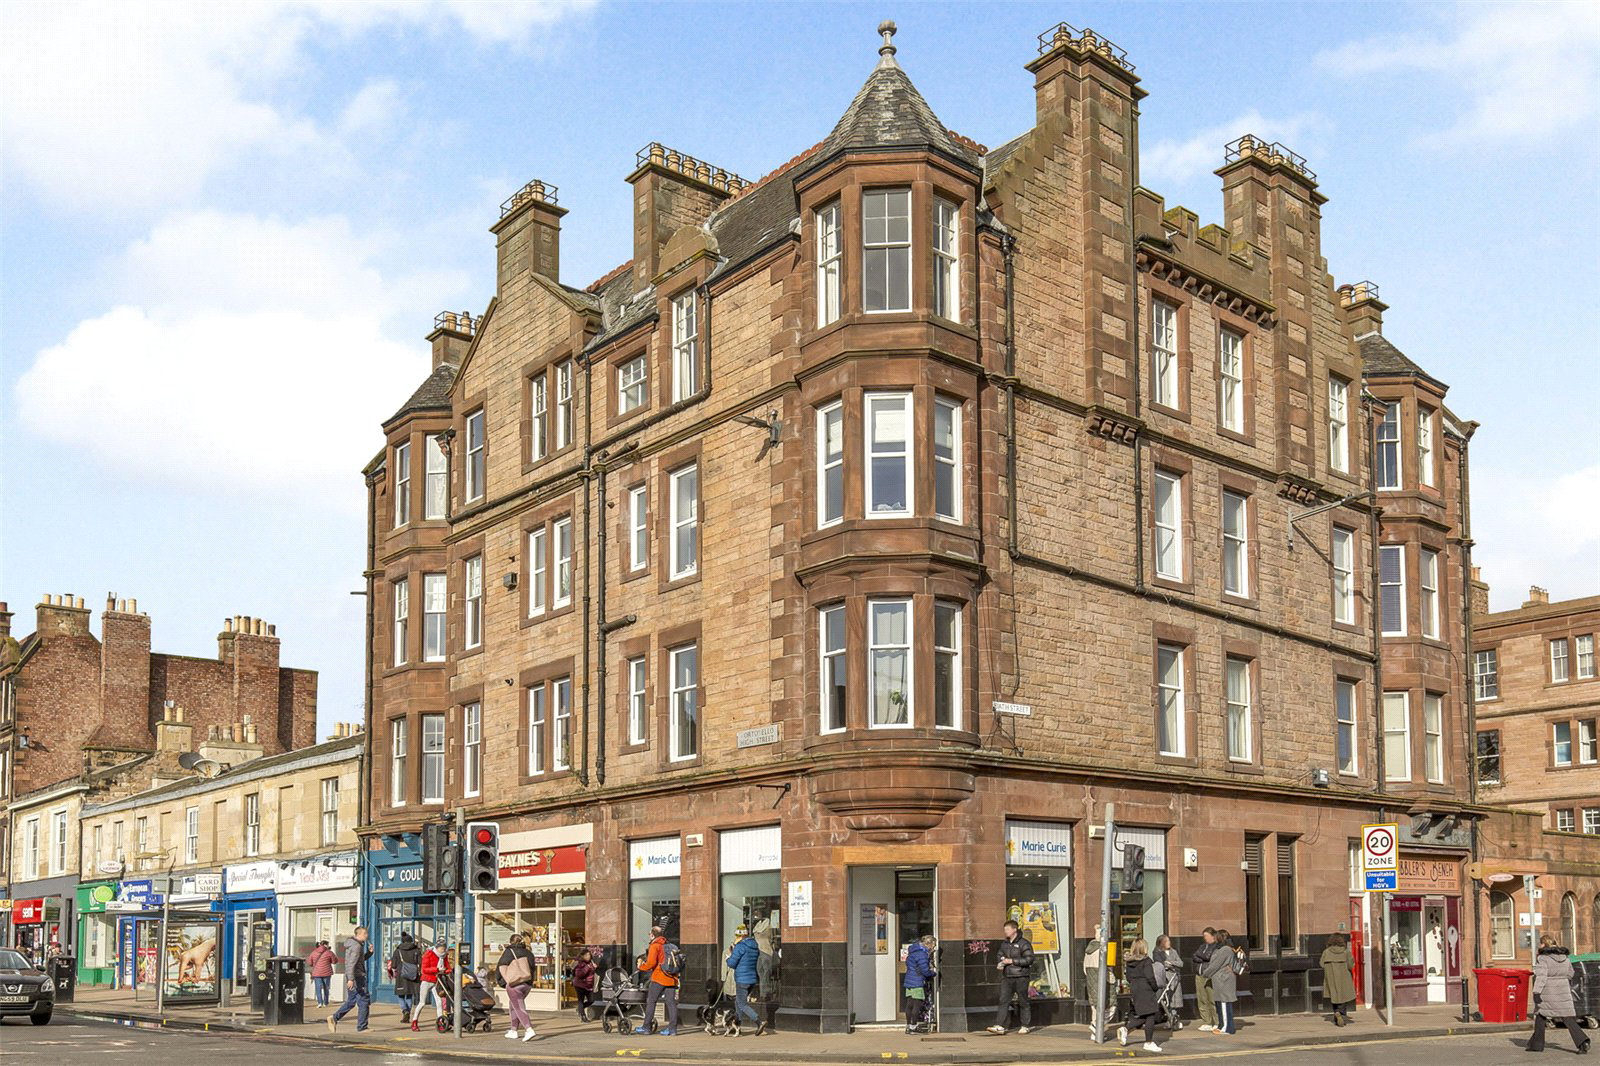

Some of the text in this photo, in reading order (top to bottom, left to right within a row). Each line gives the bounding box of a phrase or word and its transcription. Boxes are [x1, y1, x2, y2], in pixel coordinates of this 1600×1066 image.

[1010, 704, 1029, 713] STREET
[756, 734, 774, 744] STREET
[1022, 840, 1066, 852] Marie Curie
[1370, 836, 1390, 848] 20
[648, 854, 666, 864] Marie
[1368, 856, 1392, 865] ZONE
[1430, 861, 1454, 882] BENCH
